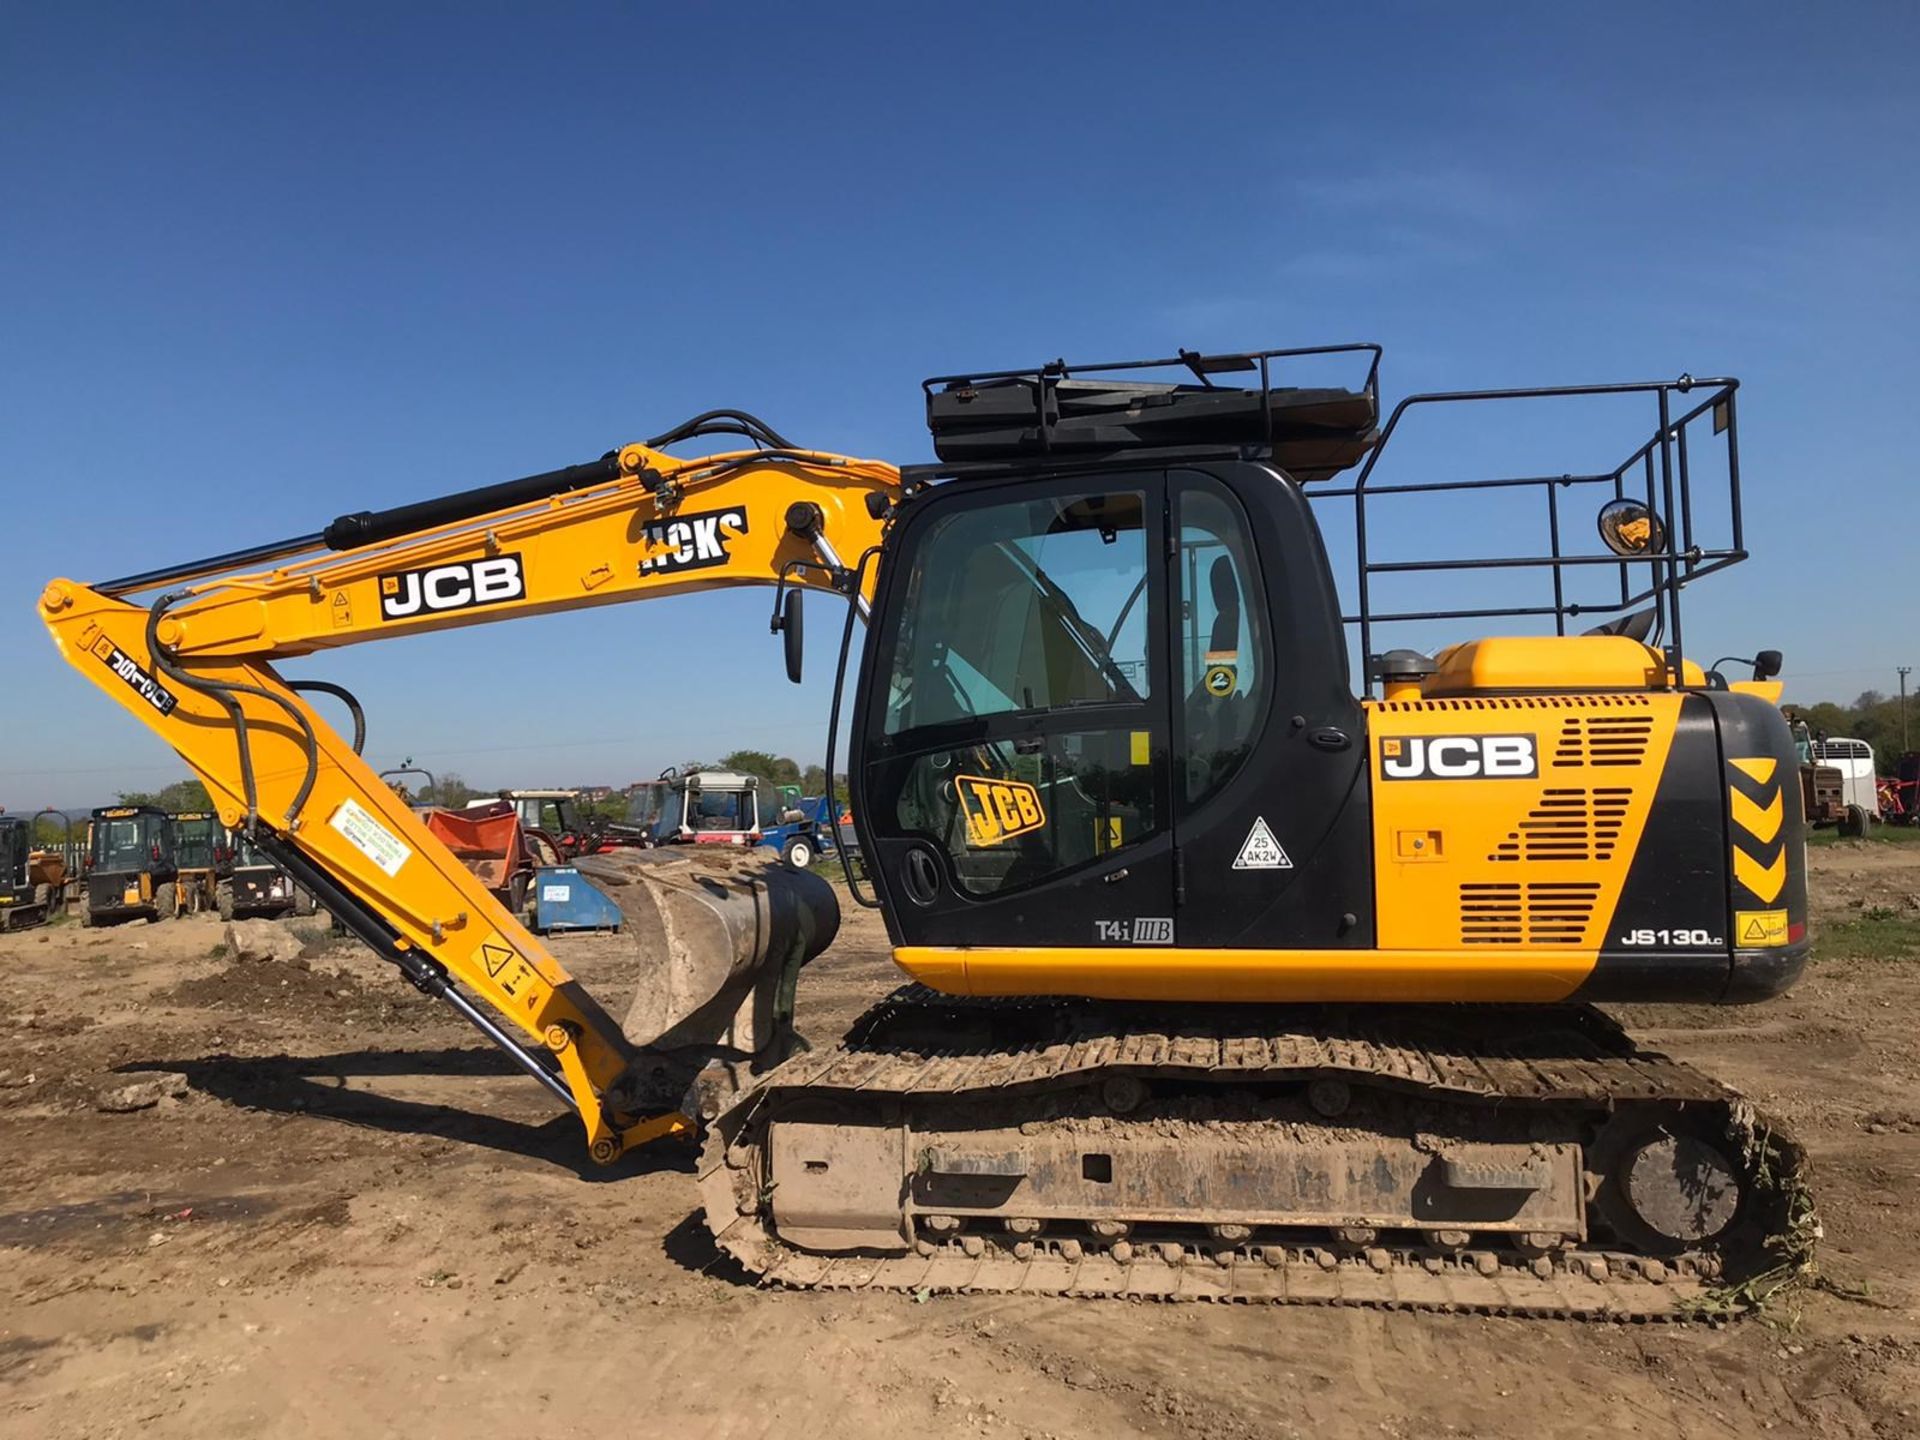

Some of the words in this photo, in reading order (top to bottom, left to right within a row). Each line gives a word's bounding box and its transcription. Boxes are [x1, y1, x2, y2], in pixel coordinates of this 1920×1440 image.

[384, 557, 522, 616] JCB
[1384, 737, 1535, 777] JCB
[971, 783, 1039, 839] JCB
[1254, 837, 1269, 848] 25
[1095, 921, 1131, 941] T4i
